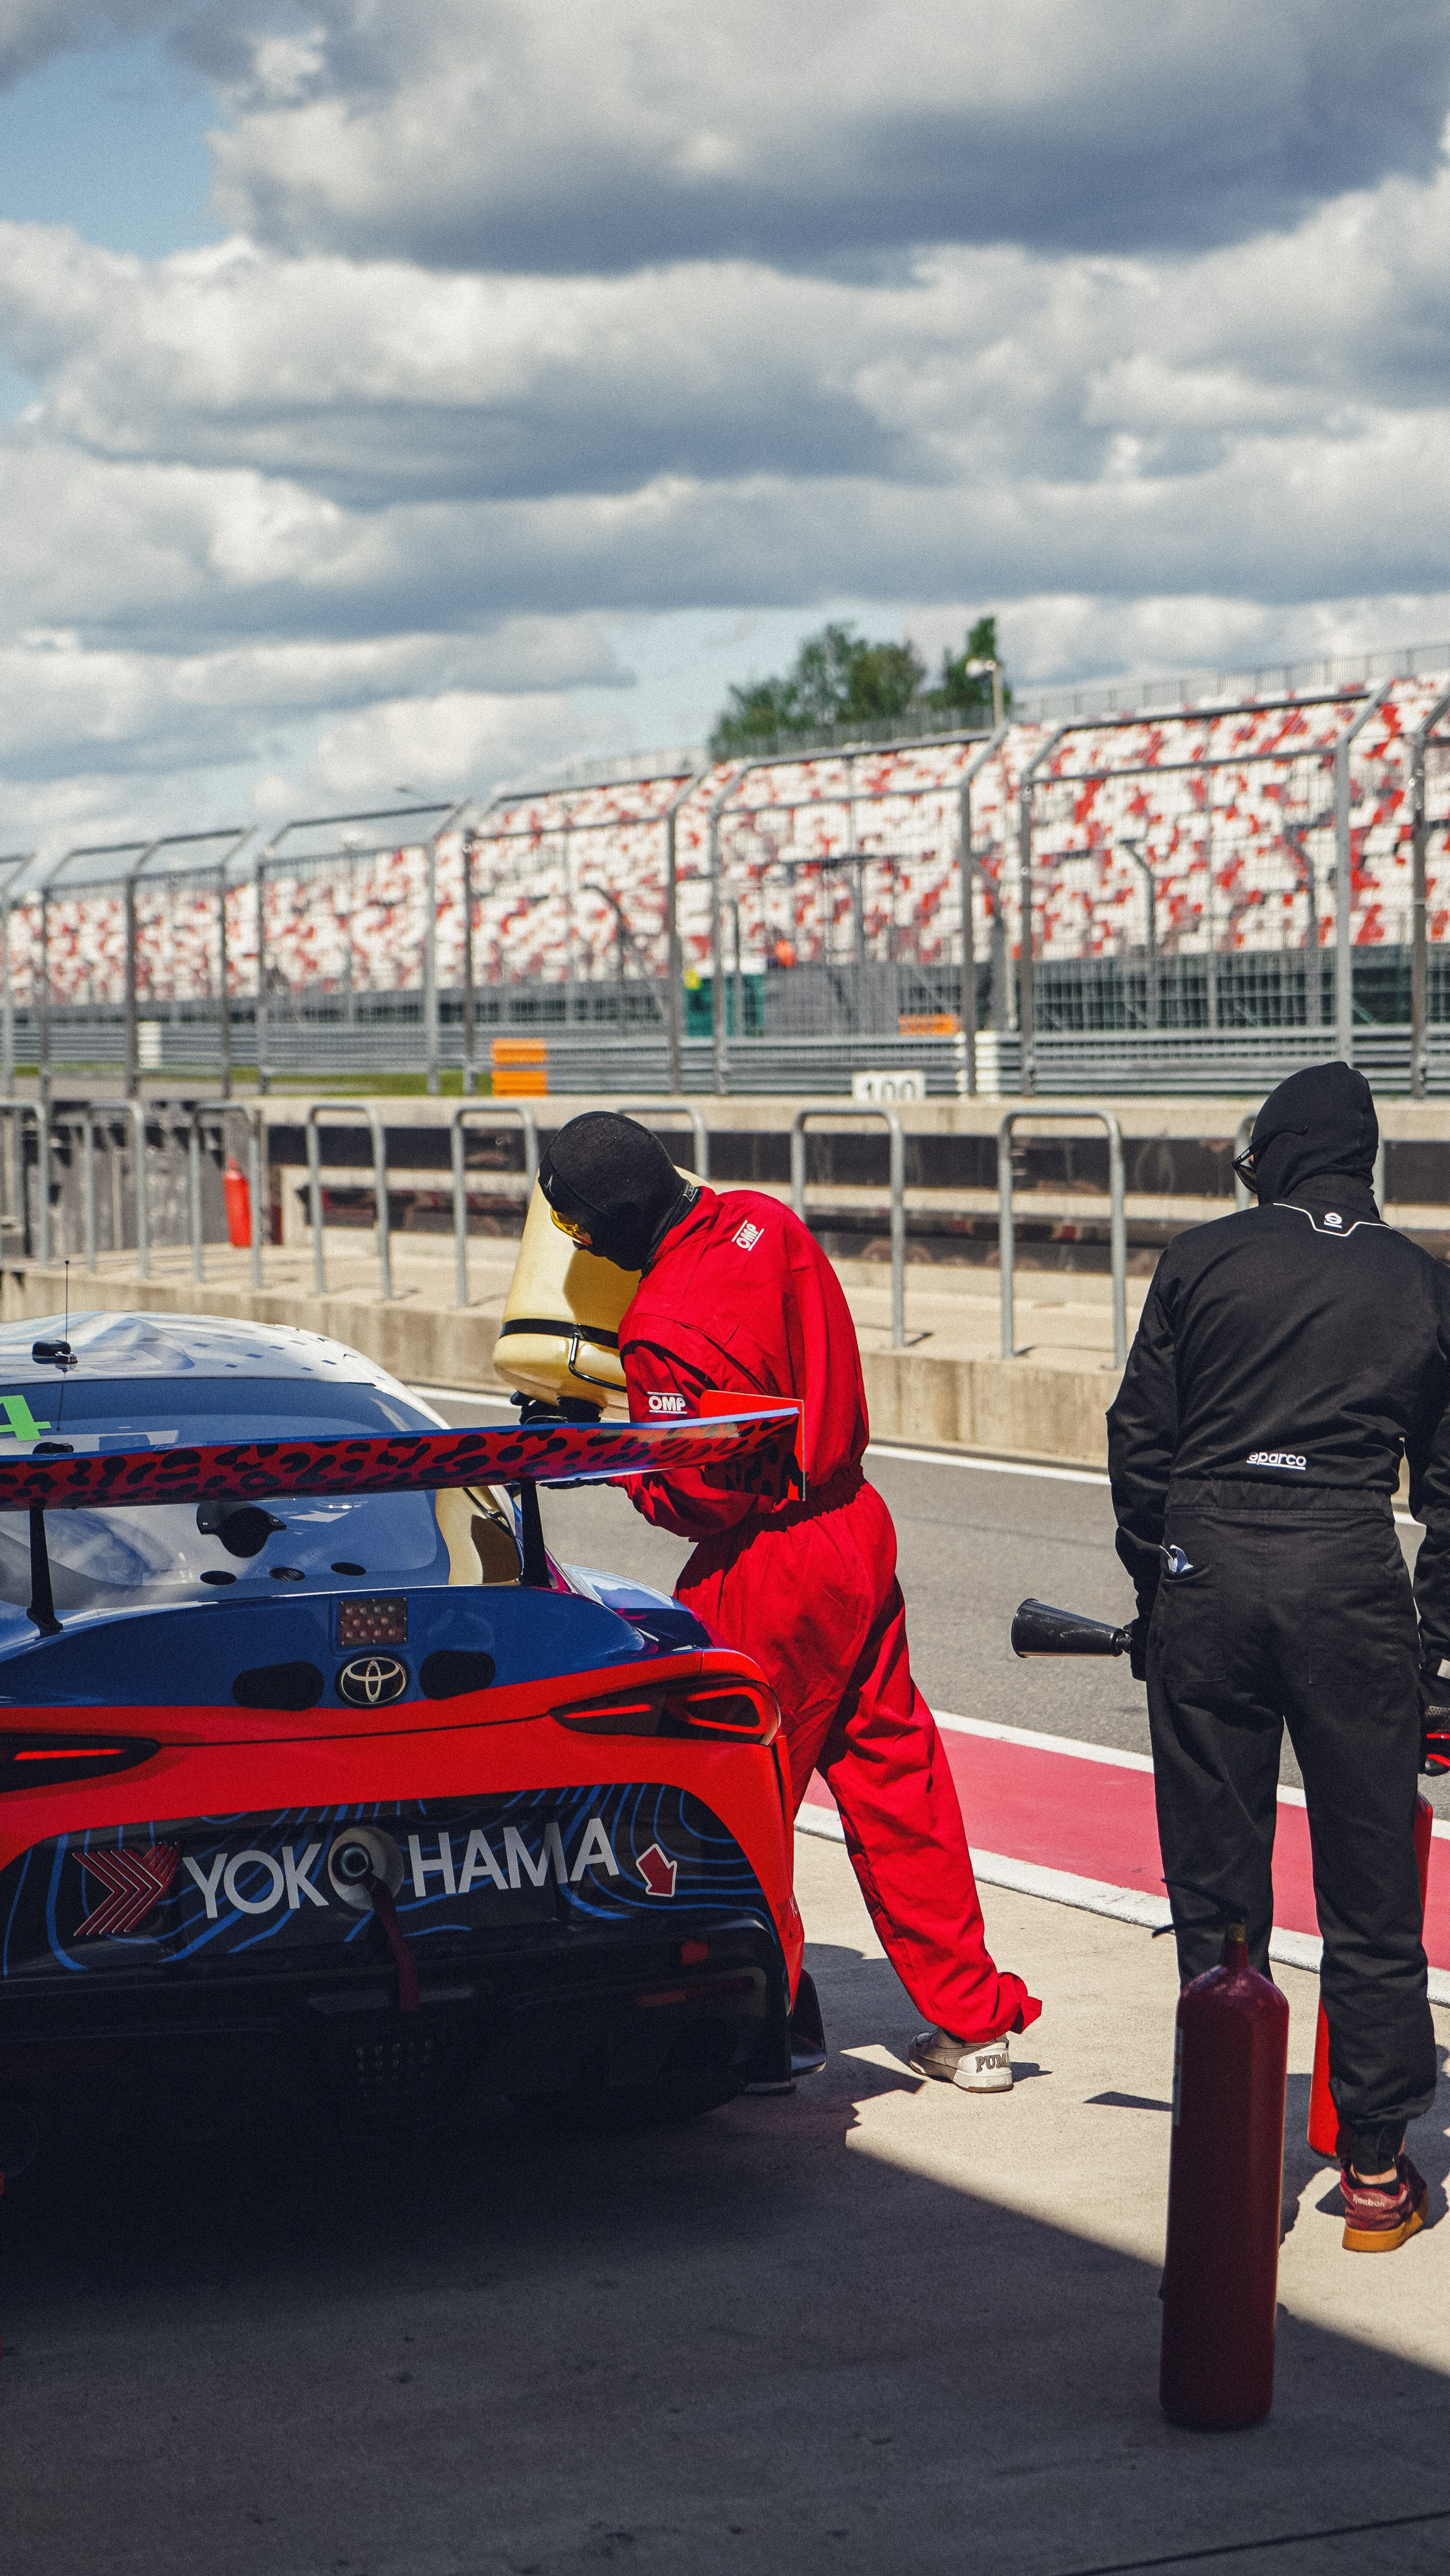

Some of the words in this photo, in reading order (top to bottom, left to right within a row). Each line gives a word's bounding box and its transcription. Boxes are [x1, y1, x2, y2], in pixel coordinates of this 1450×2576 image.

[864, 1079, 916, 1099] 100
[736, 1223, 759, 1249] OMP
[648, 1396, 686, 1411] OMP
[1352, 2194, 1385, 2207] Reebok
